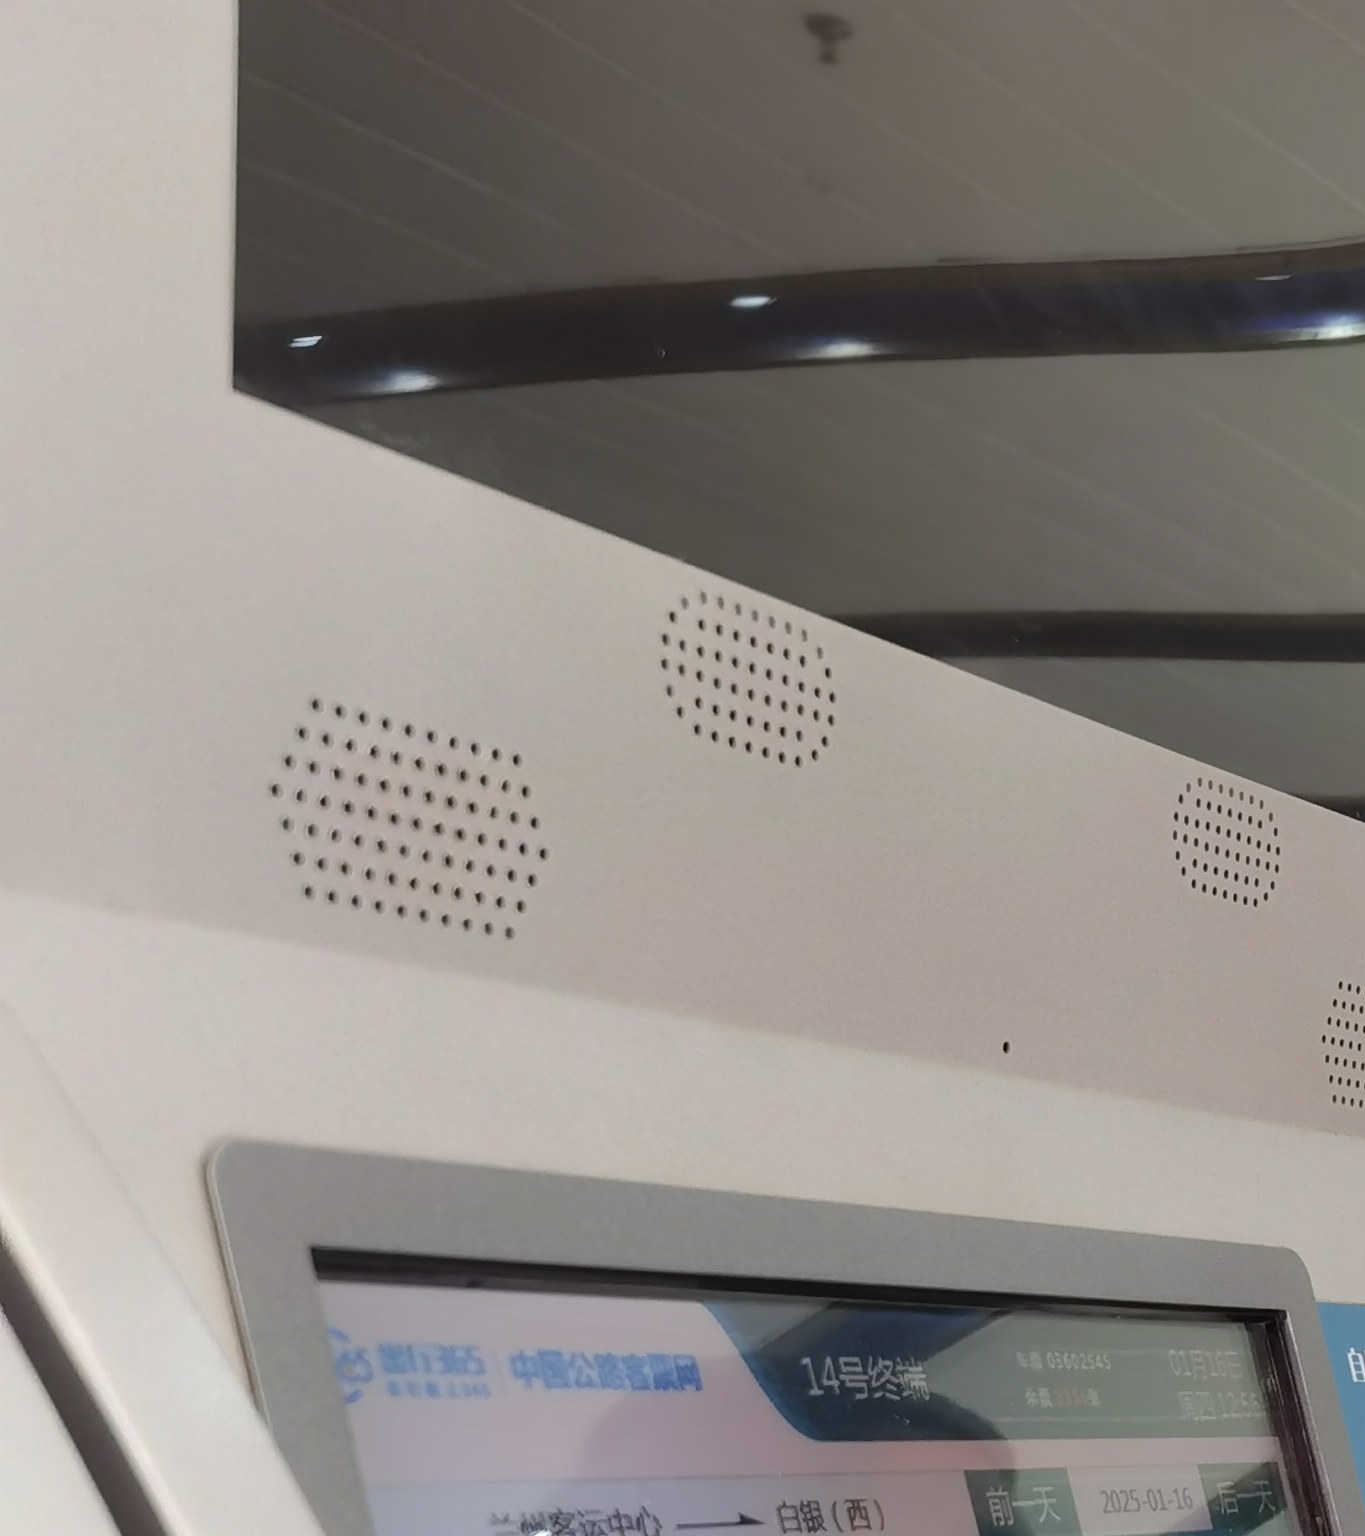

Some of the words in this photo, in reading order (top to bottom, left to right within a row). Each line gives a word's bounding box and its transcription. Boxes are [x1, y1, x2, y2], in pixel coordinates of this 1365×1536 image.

[801, 1355, 930, 1400] 14号终端
[986, 1485, 1061, 1527] 前一天
[1102, 1486, 1194, 1516] 2025-01-16
[1217, 1480, 1278, 1515] 后一天
